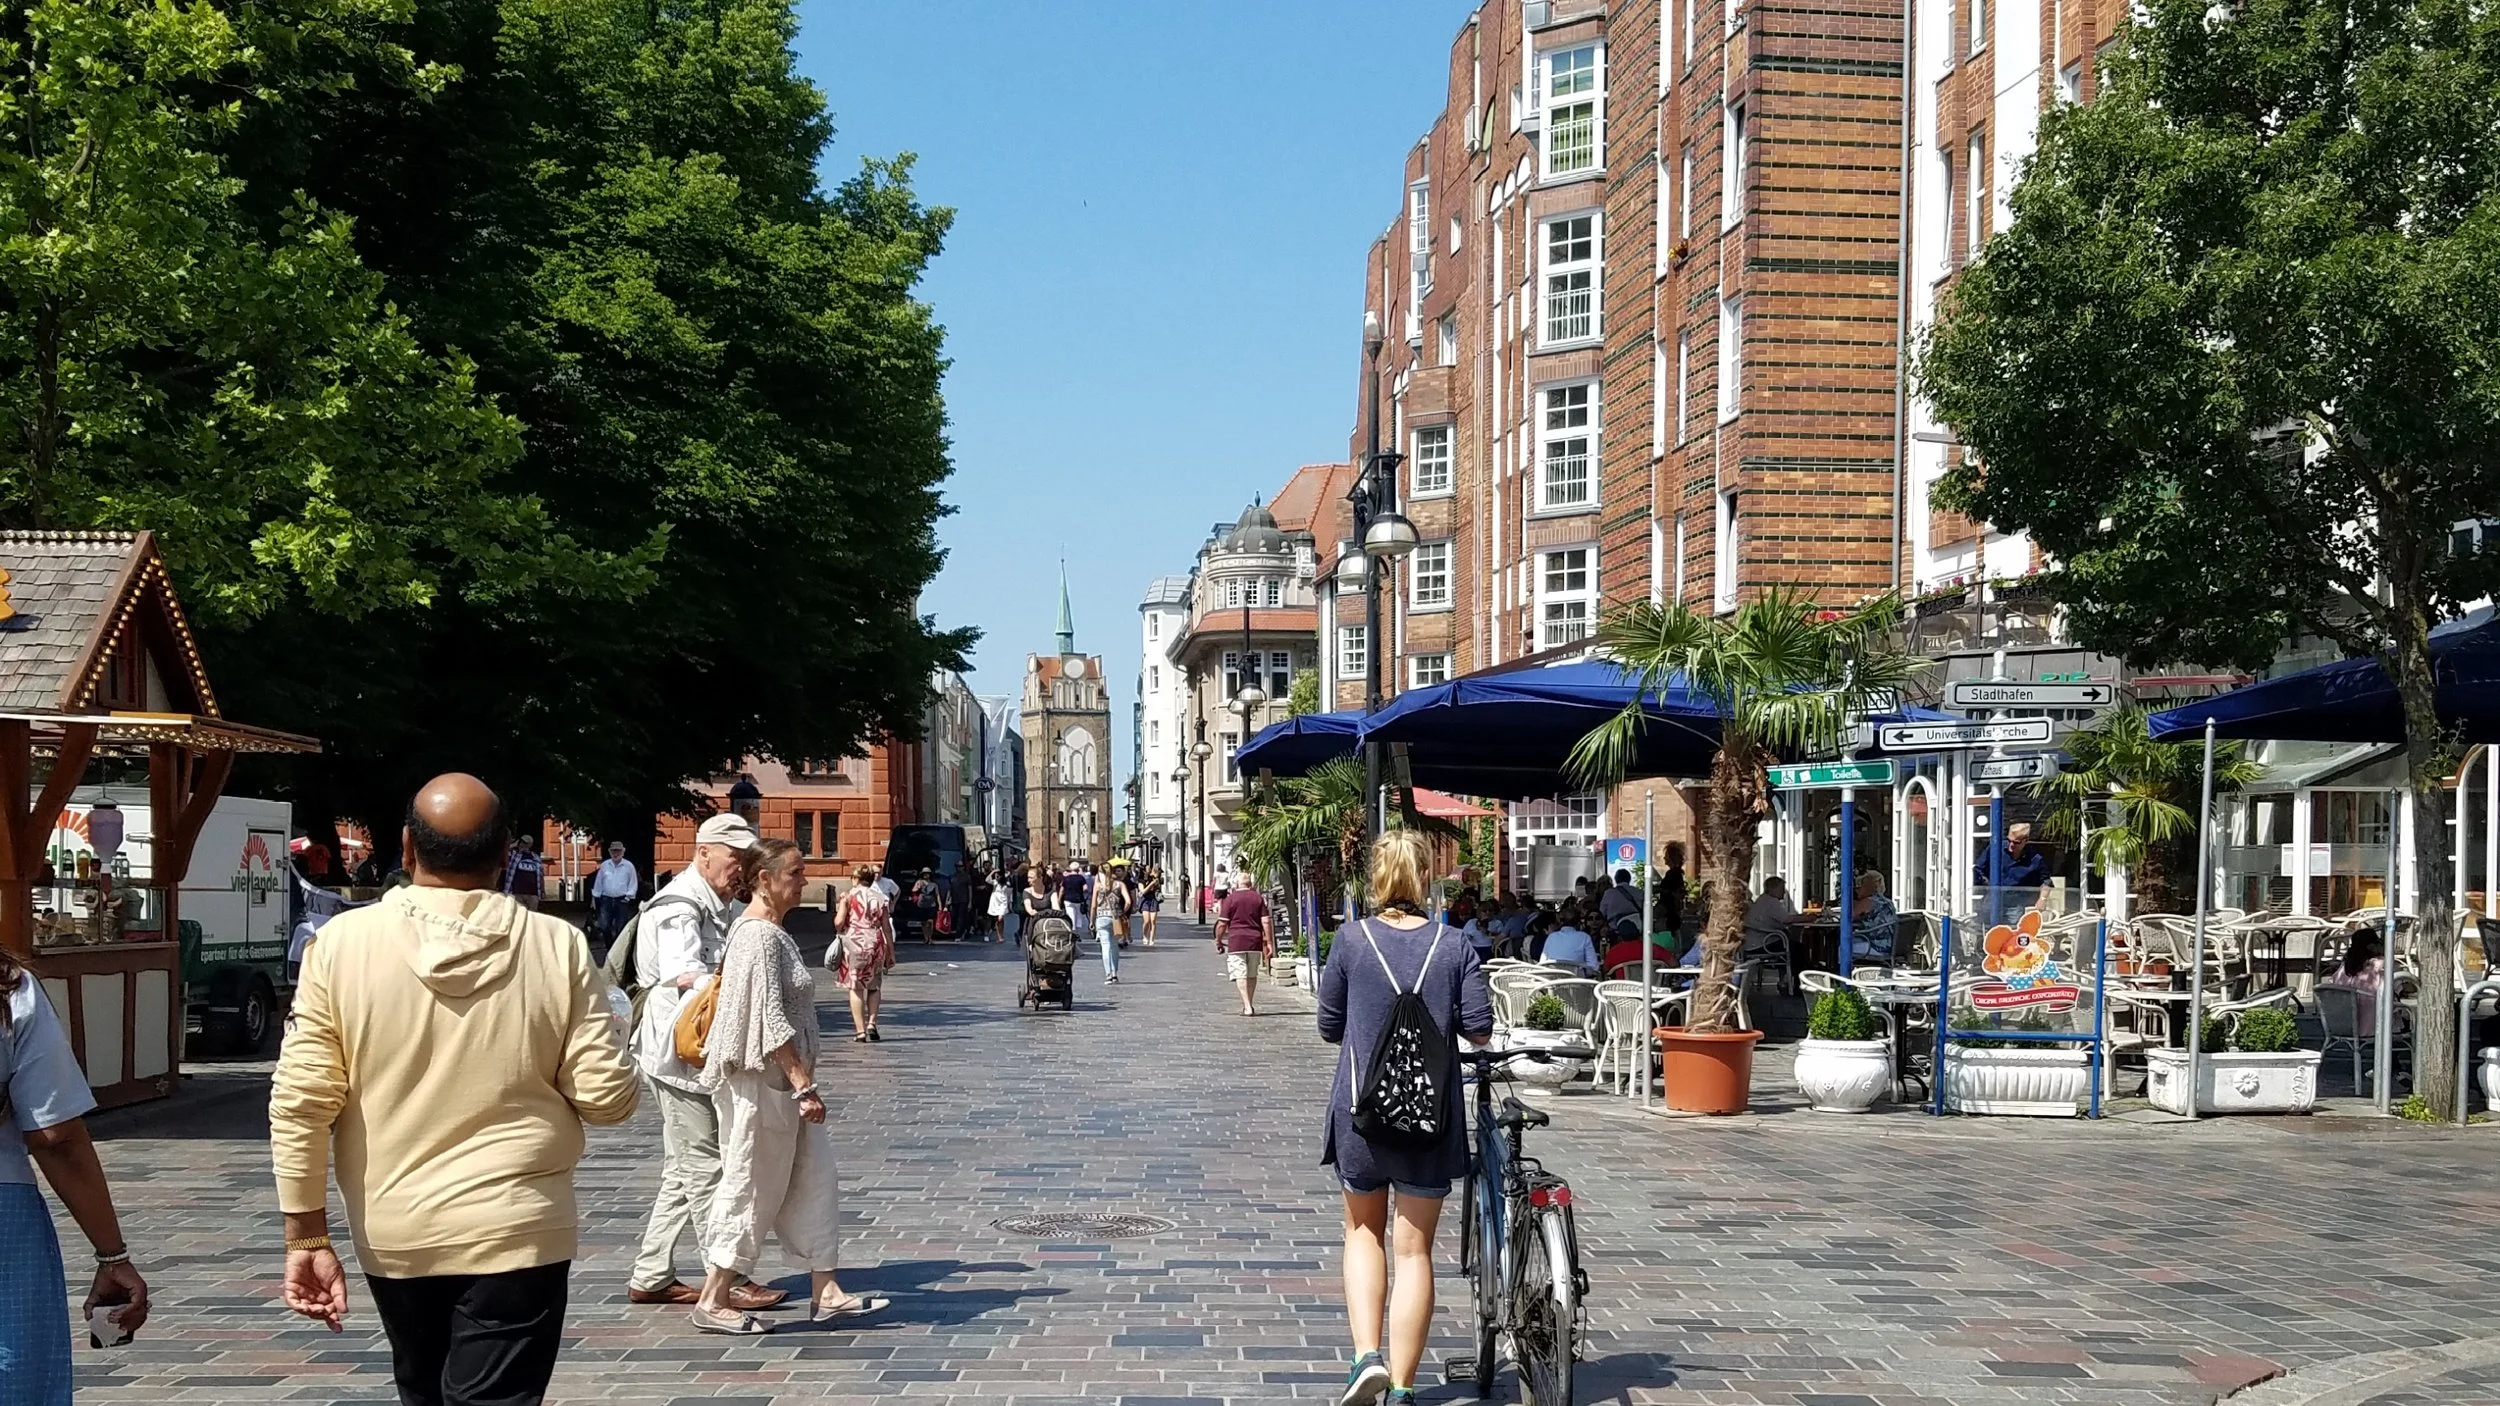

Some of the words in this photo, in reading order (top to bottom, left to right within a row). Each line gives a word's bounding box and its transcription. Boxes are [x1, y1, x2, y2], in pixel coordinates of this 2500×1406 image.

[1971, 688, 2033, 700] Stadthafen
[1926, 726, 2028, 740] Universitätsrche
[1830, 768, 1862, 779] Toilette
[230, 870, 279, 893] vierlande
[228, 946, 238, 960] für
